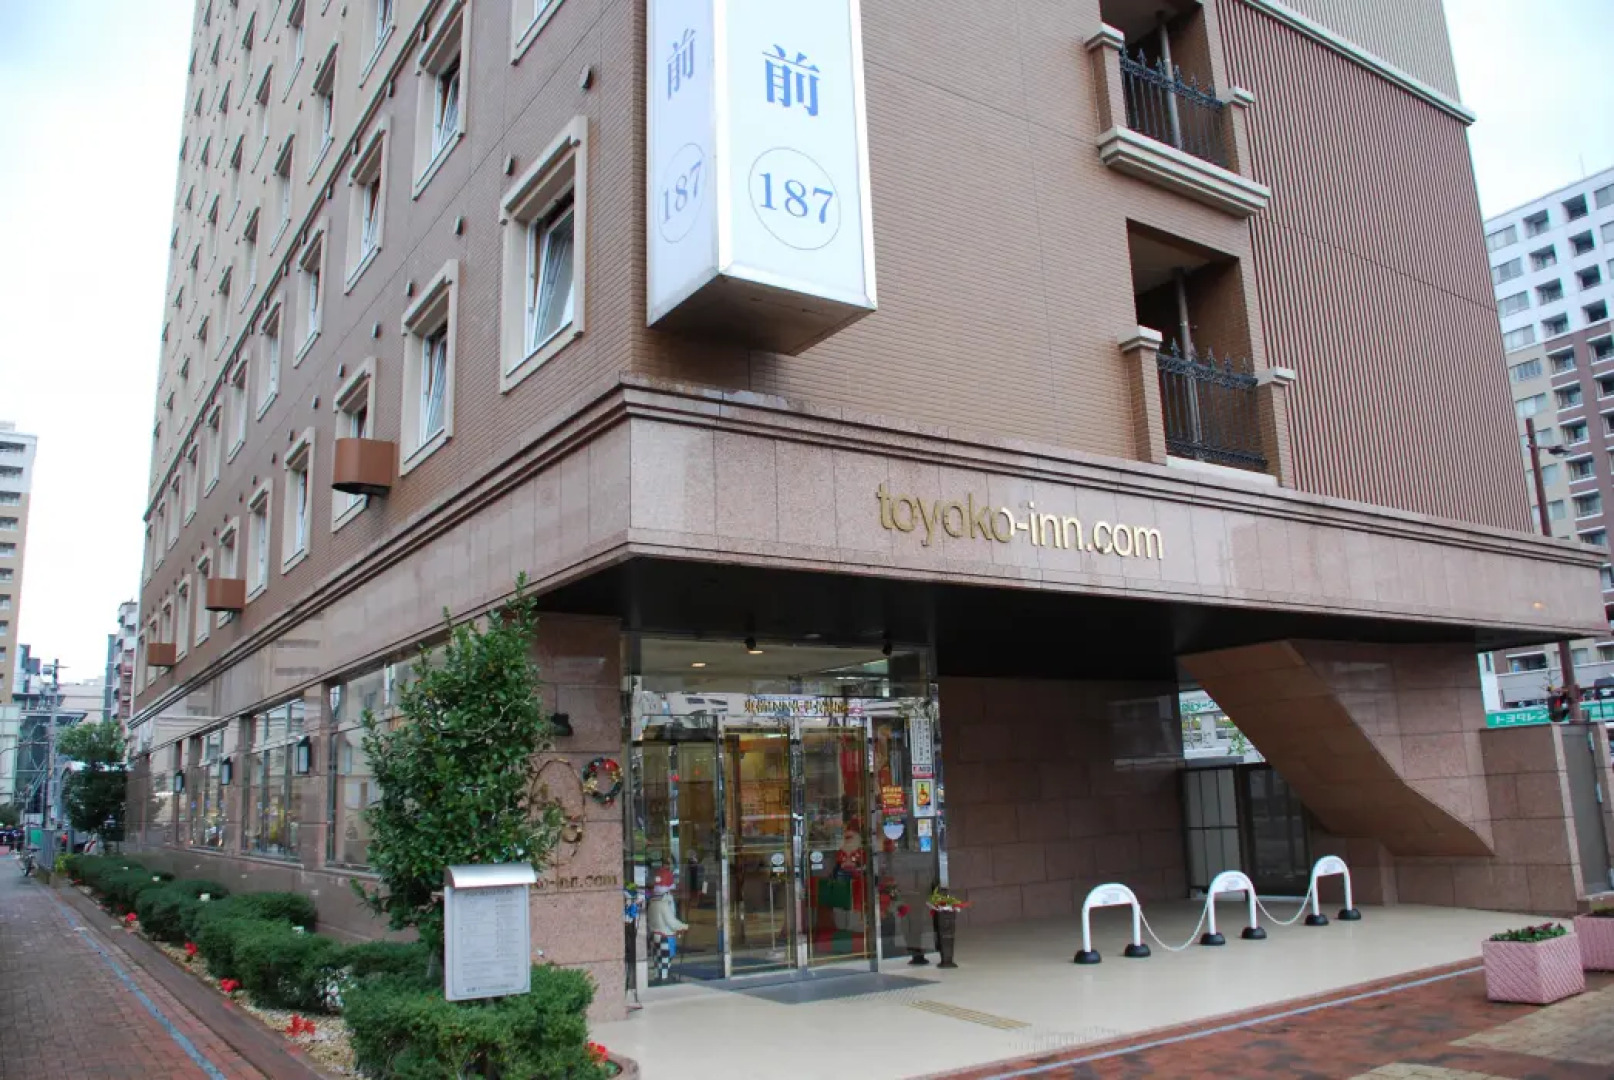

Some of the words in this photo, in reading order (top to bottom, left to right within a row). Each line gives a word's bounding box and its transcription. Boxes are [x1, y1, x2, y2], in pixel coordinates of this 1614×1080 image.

[667, 28, 696, 99] 前
[761, 43, 820, 117] 前
[663, 161, 702, 224] 187
[759, 172, 834, 224] 187
[875, 483, 1164, 560] toyoko-inn.com
[1496, 710, 1549, 724] トヨタレン
